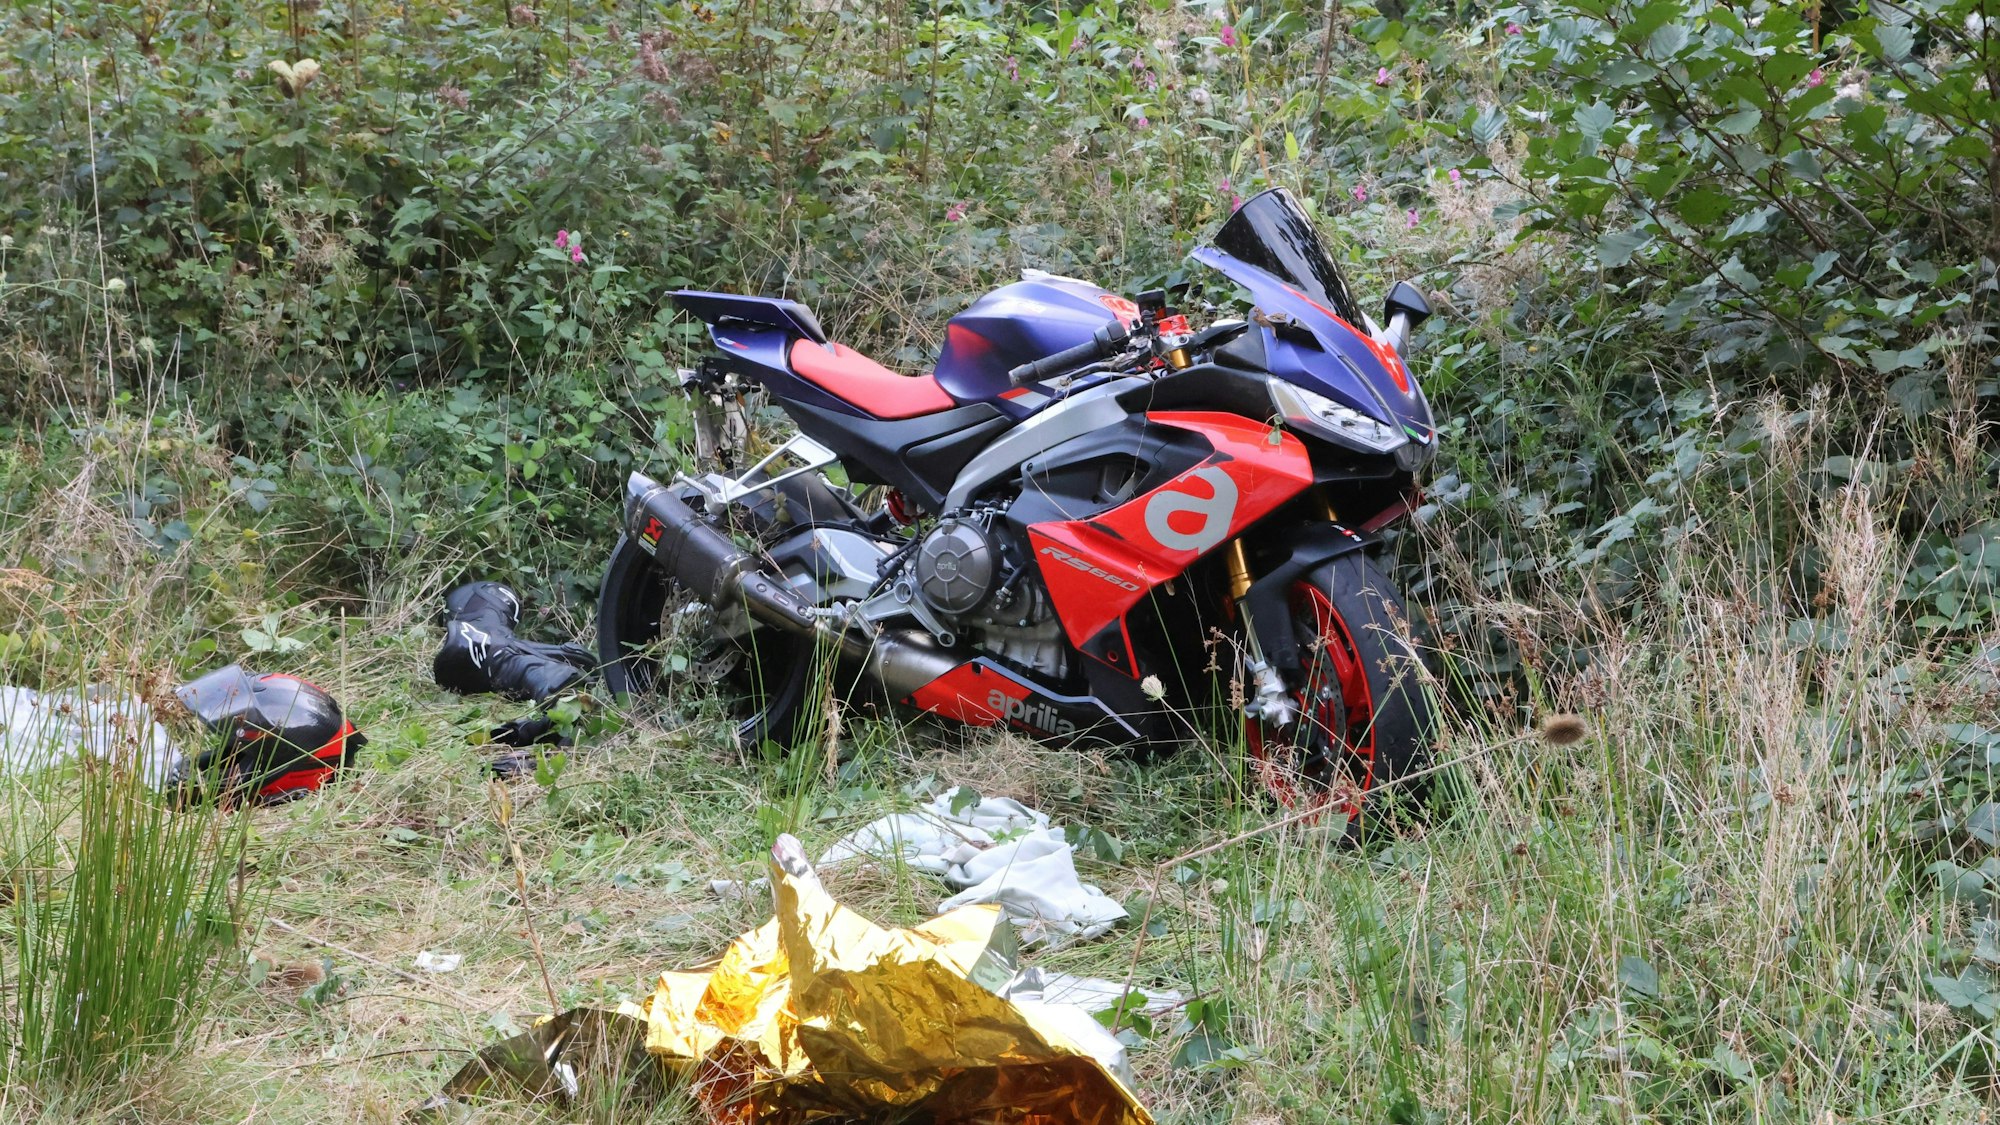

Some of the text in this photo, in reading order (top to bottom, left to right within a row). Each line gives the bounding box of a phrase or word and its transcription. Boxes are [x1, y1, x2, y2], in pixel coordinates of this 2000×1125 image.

[1144, 465, 1239, 555] a
[1039, 546, 1141, 592] RS660
[987, 688, 1076, 740] aprilia
